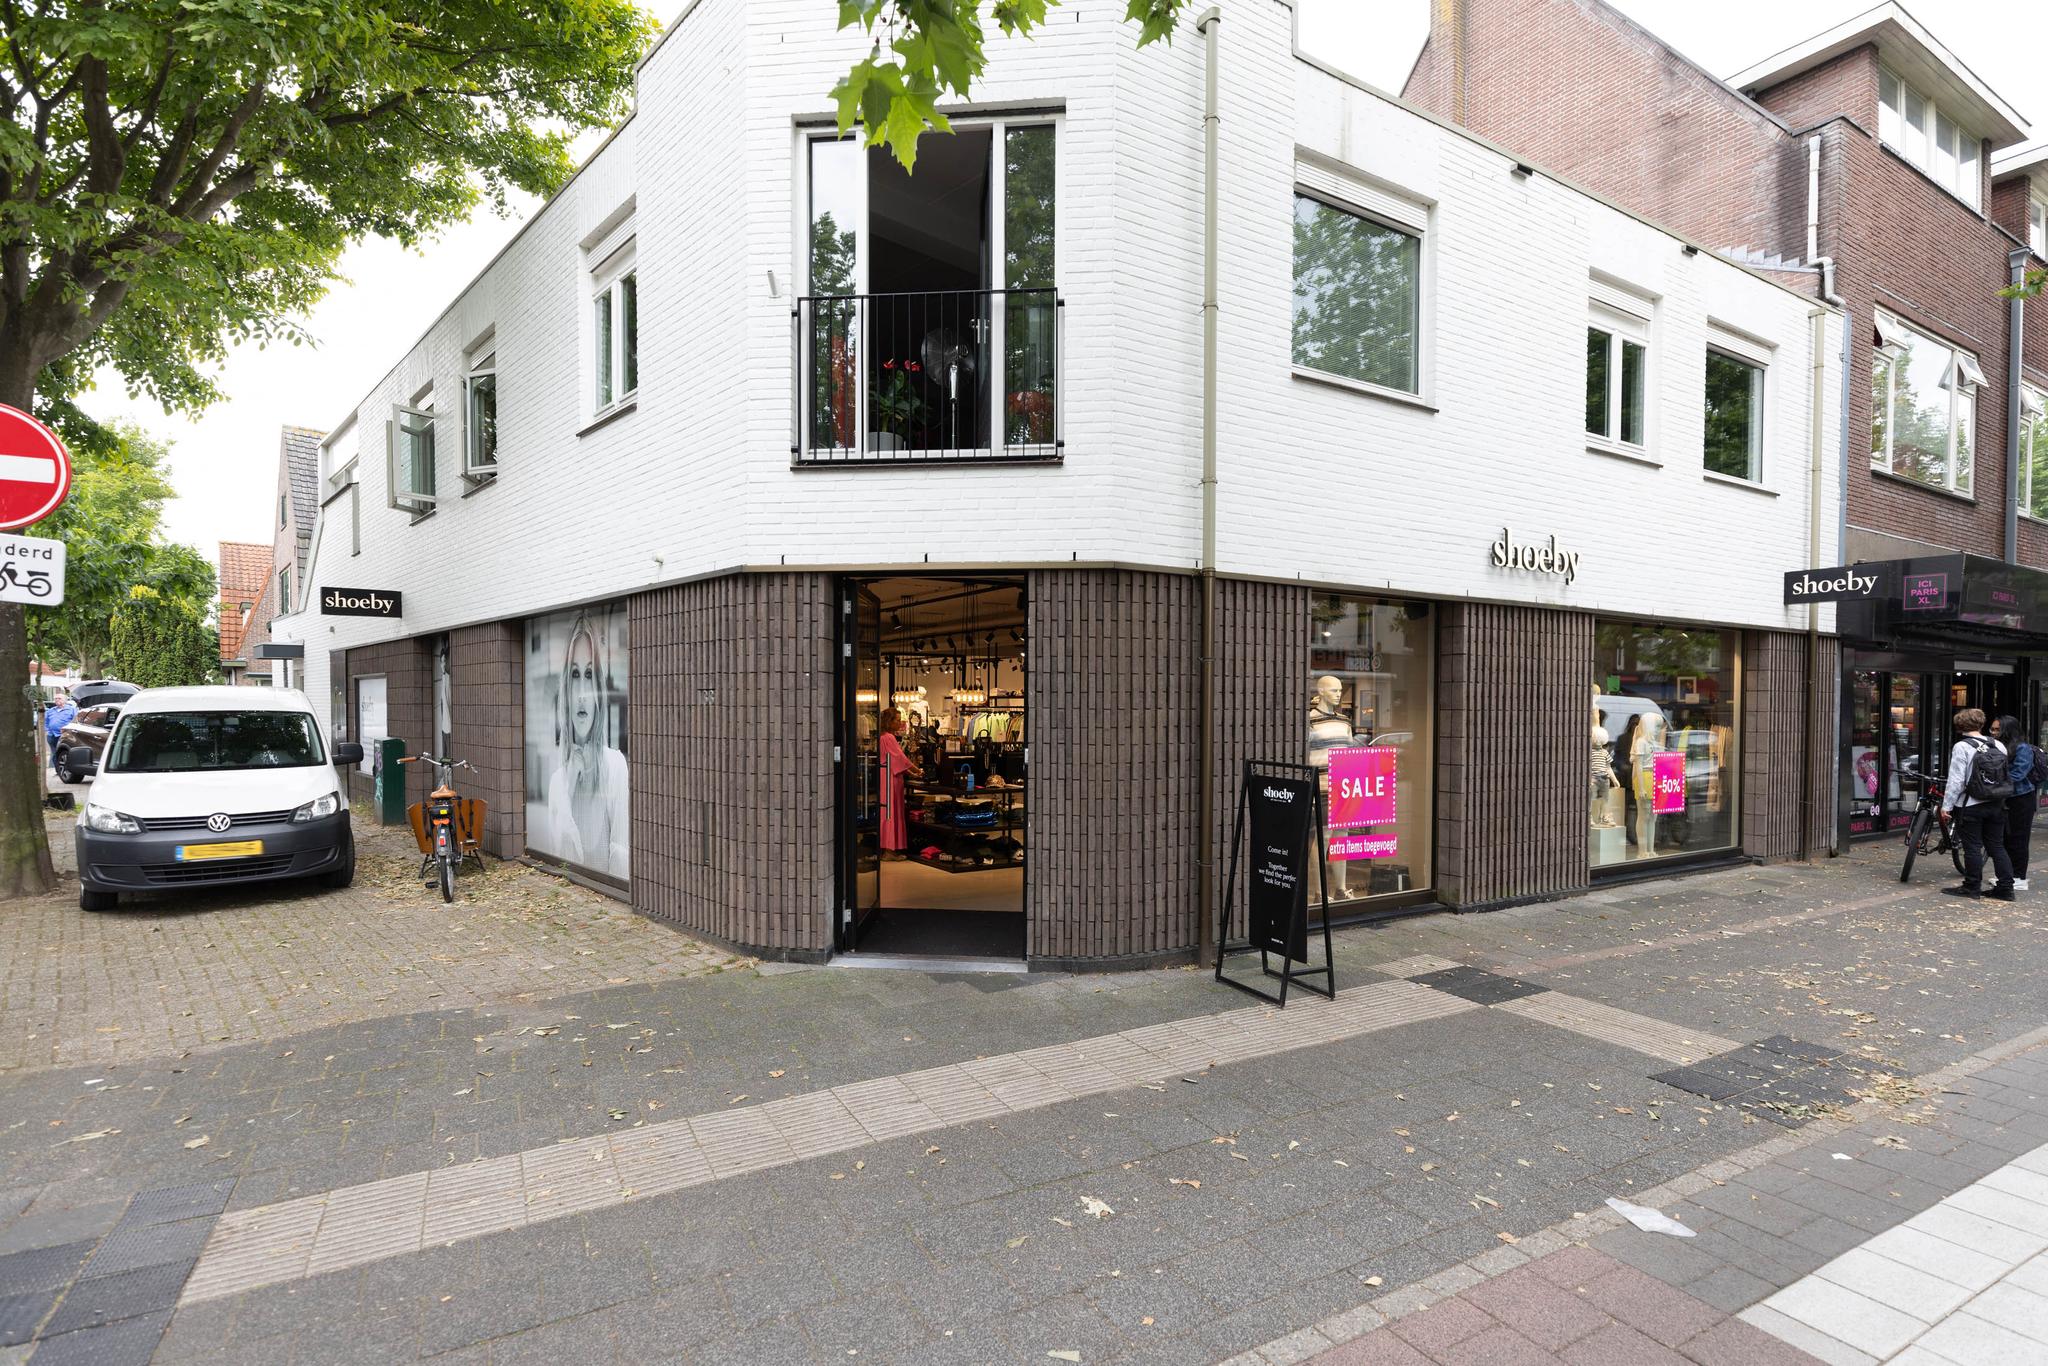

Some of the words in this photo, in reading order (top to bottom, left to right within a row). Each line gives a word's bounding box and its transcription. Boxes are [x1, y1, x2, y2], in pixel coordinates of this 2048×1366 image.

[0, 543, 52, 560] derd
[1491, 527, 1580, 585] shoeby
[1792, 570, 1878, 595] shoeby
[1918, 580, 1932, 588] ICI
[1910, 587, 1939, 596] PARIS
[1918, 596, 1931, 604] XL
[325, 591, 394, 613] shoeby
[1263, 786, 1295, 803] shoeby
[1341, 776, 1385, 799] SALE
[1658, 779, 1680, 793] -50%
[1267, 845, 1281, 855] Come
[1329, 841, 1345, 855] extra
[1346, 840, 1362, 854] items
[1364, 837, 1397, 855] toegevoegd
[1282, 874, 1297, 882] perfec
